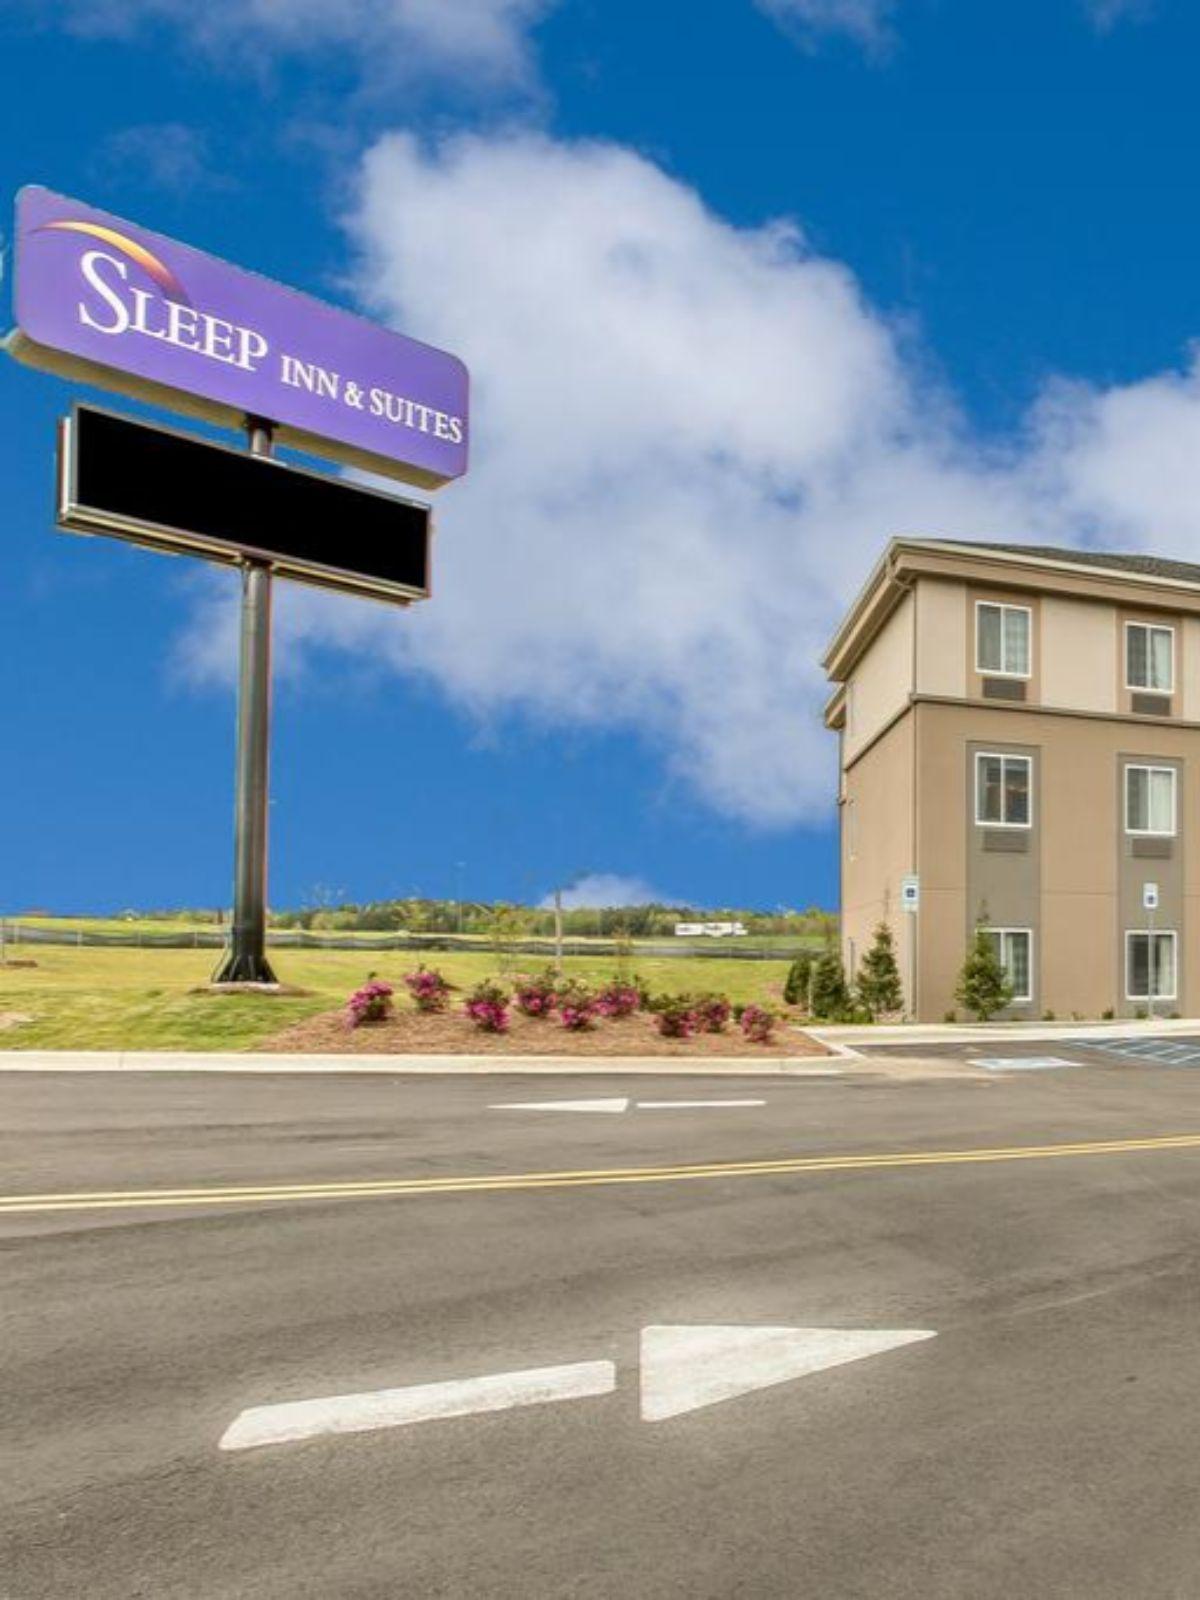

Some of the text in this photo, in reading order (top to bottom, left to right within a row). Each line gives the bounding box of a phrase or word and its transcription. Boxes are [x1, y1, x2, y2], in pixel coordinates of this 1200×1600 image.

[79, 250, 463, 443] SLEEP INN & SUITES
